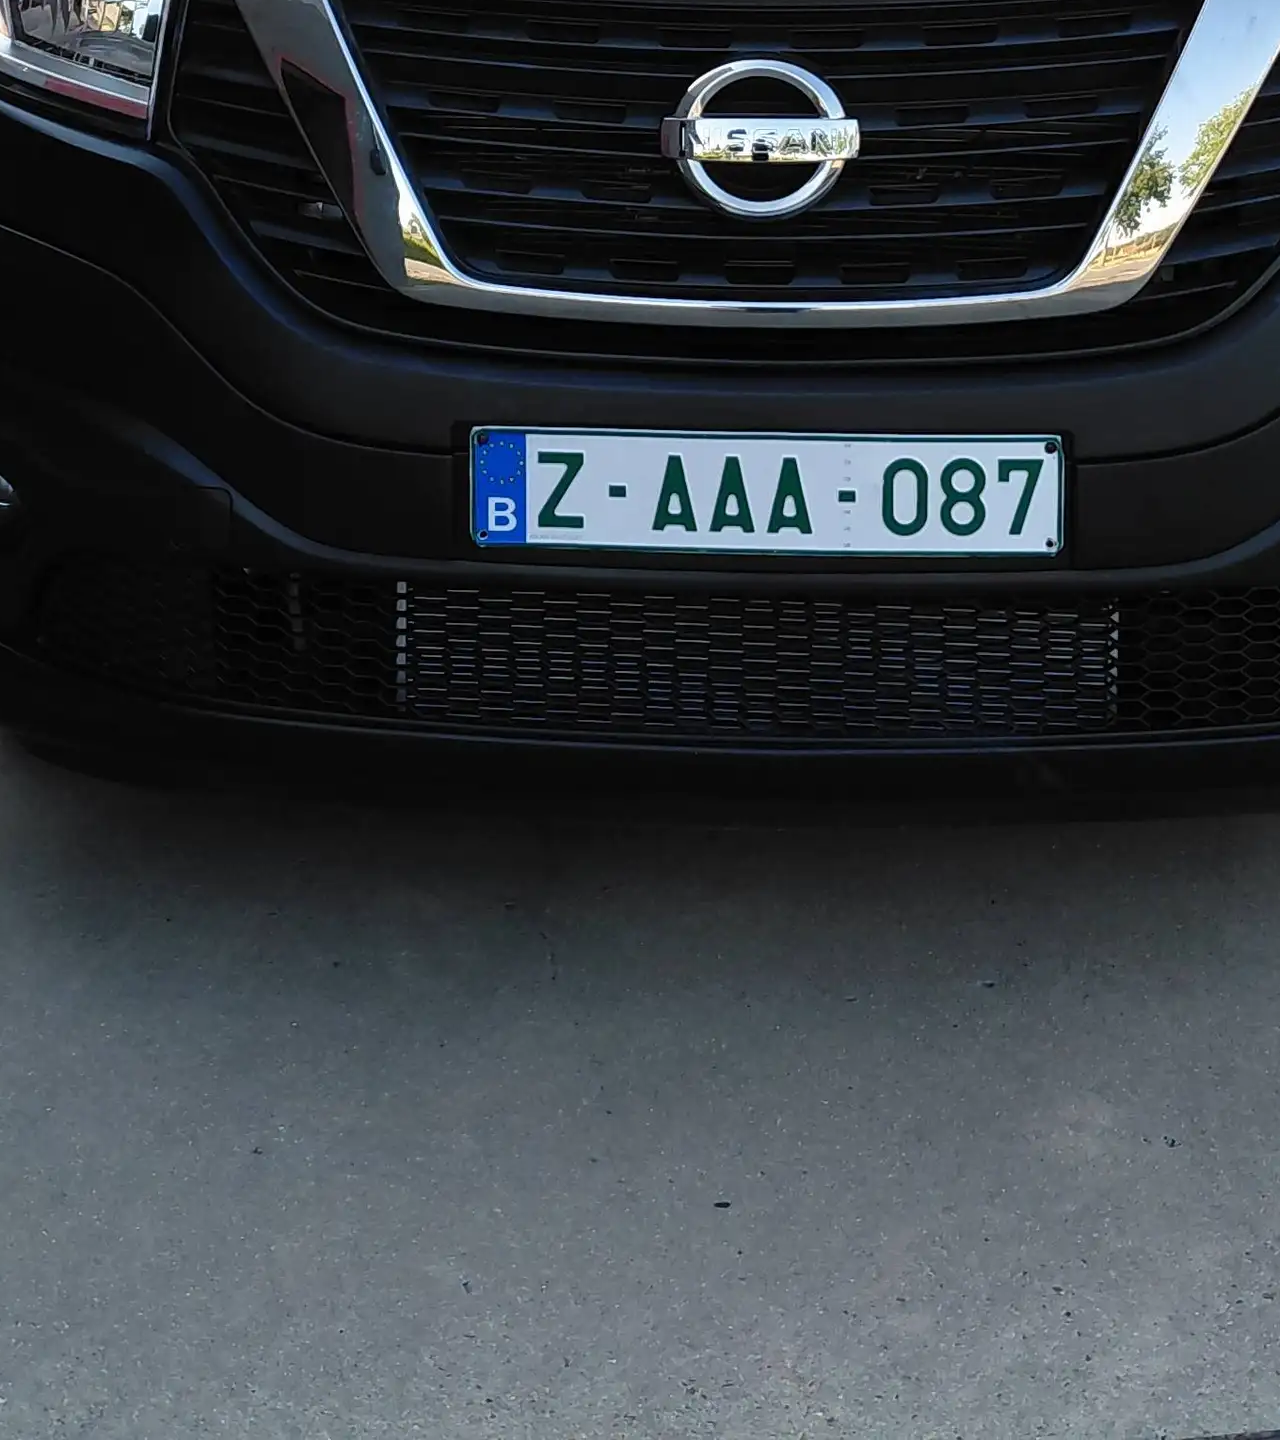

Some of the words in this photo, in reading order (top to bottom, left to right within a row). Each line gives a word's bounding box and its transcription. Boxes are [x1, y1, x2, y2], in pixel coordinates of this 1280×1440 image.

[678, 125, 851, 157] NISSAN
[537, 451, 1045, 537] Z-AAA-087
[487, 496, 518, 532] B
